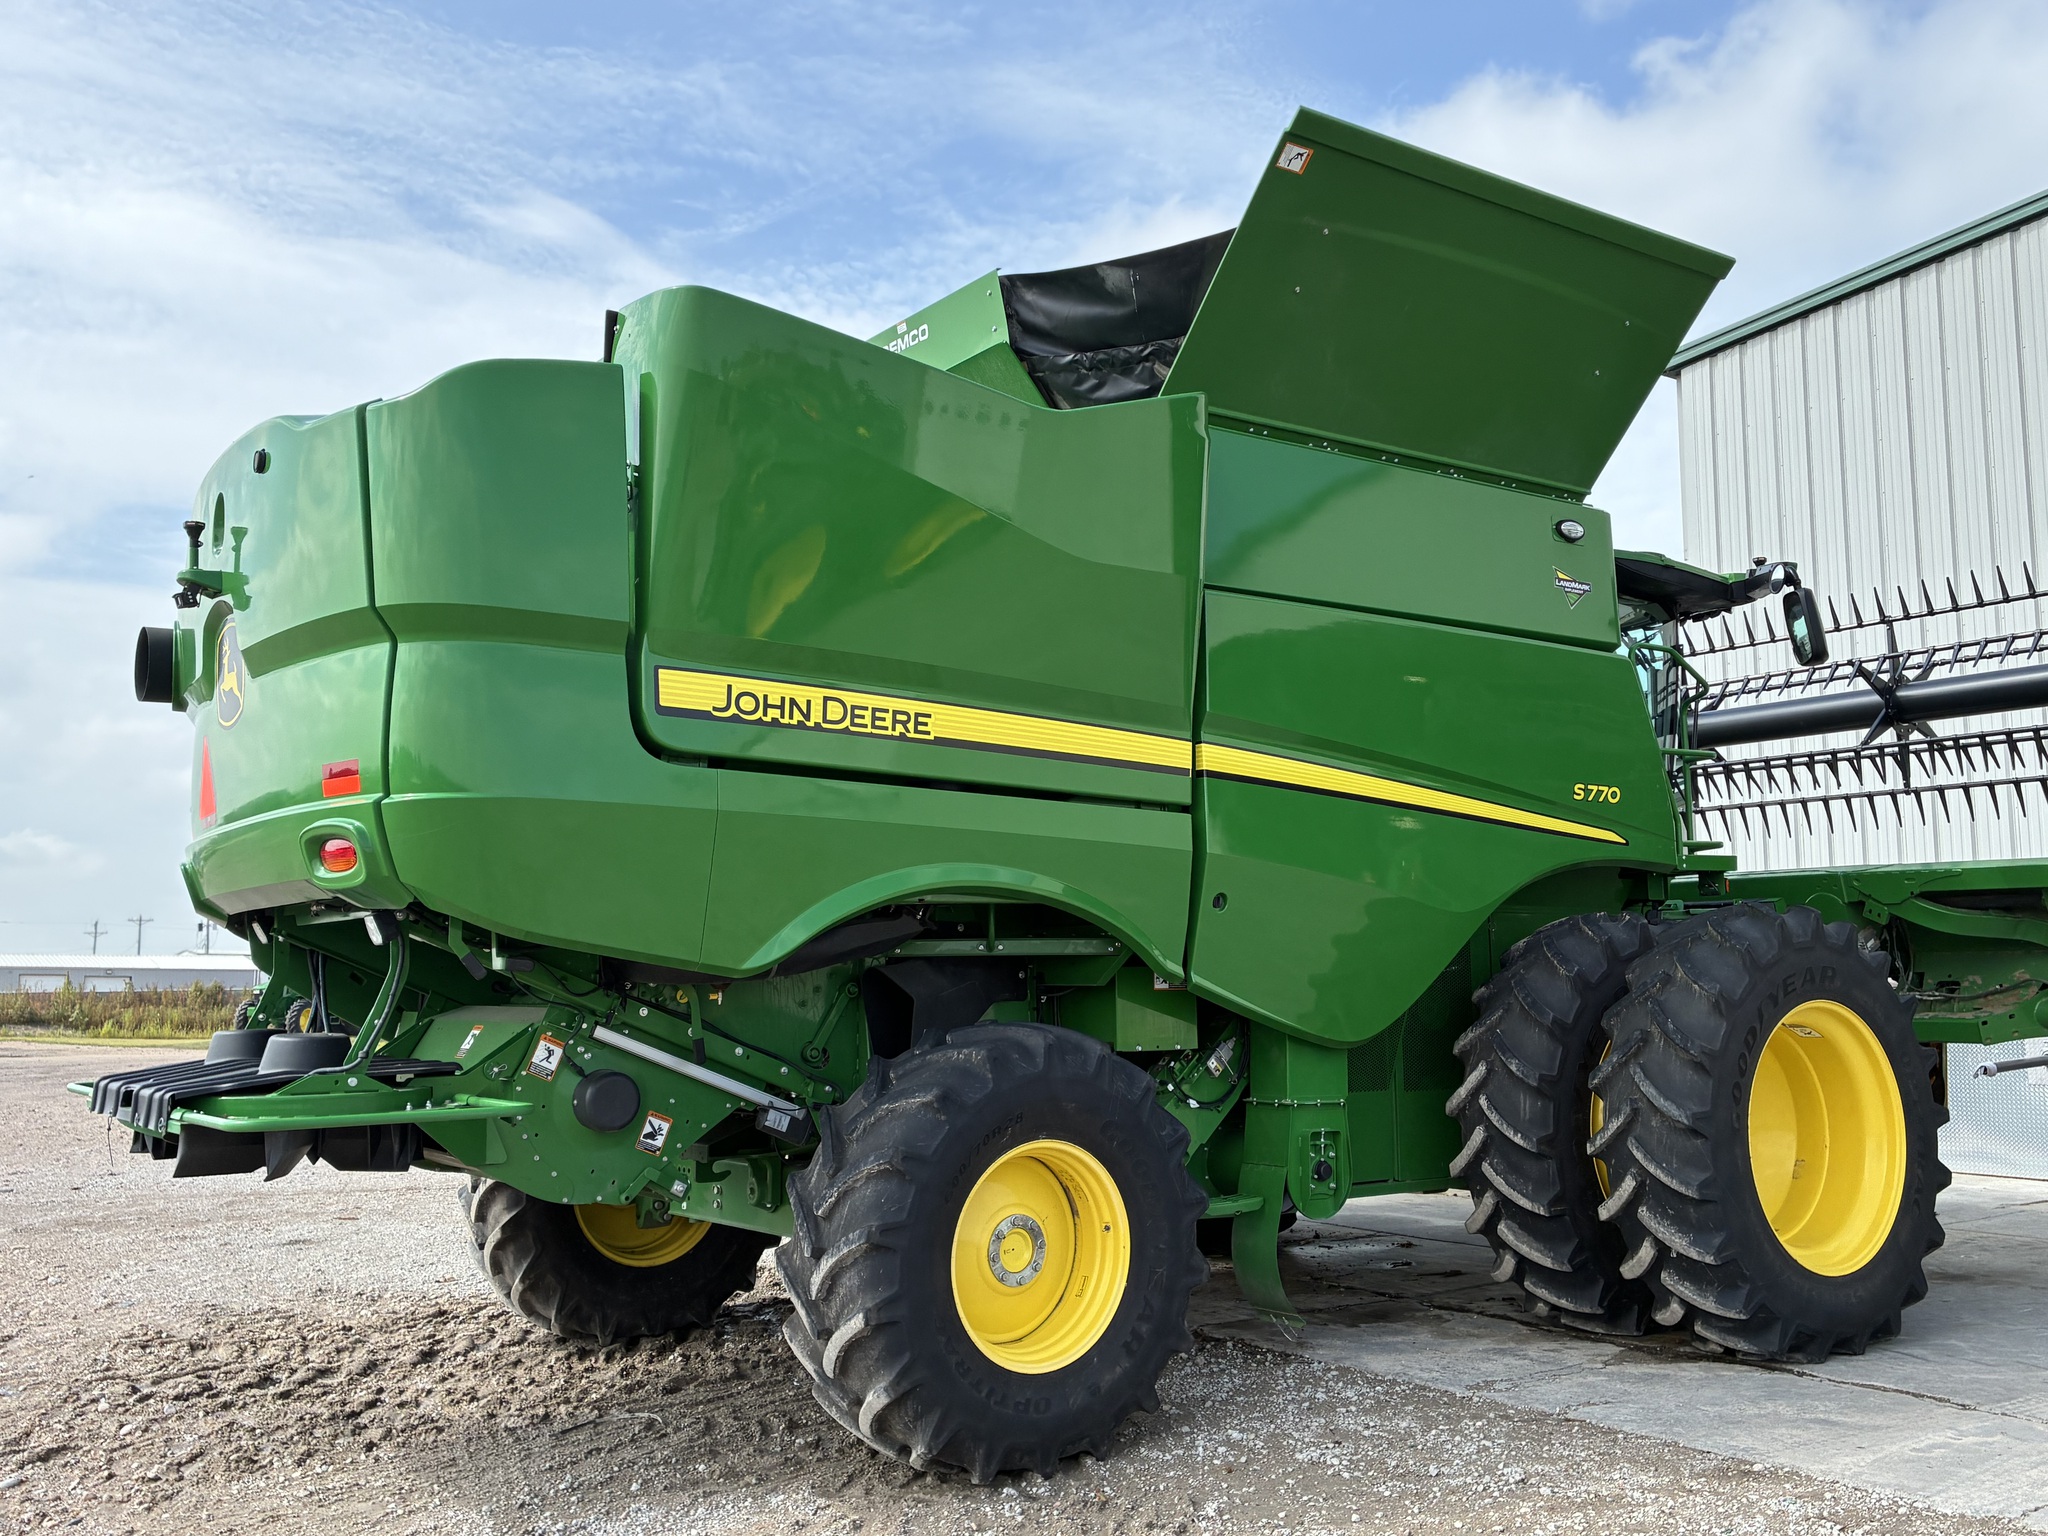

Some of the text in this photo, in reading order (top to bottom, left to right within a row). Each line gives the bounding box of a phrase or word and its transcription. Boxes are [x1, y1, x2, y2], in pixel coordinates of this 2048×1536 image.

[882, 323, 929, 353] EMCO
[712, 684, 932, 736] JOHN DEERE
[1573, 783, 1621, 804] S770
